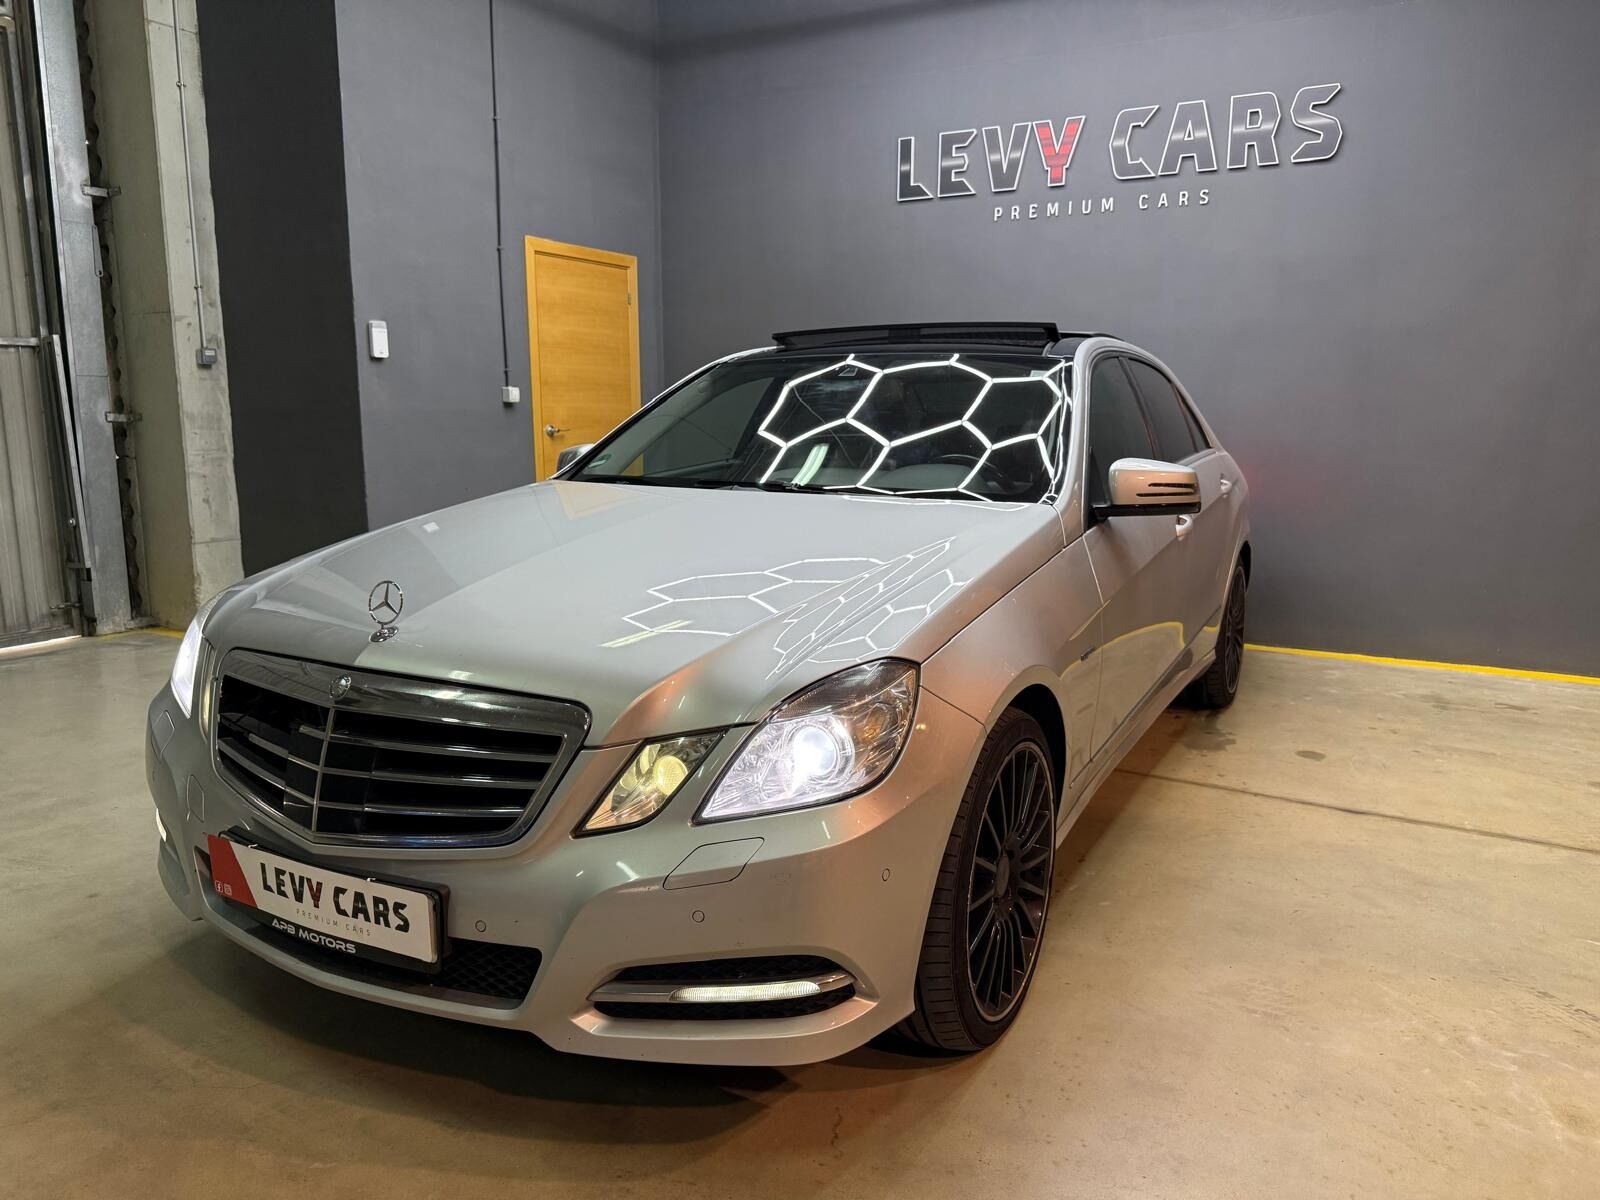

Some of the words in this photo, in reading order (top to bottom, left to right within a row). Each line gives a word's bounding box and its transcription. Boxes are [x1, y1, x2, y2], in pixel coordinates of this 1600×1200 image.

[896, 115, 1086, 202] LEVY
[1108, 83, 1343, 181] CARS
[993, 196, 1115, 221] PREMIUM
[1138, 189, 1210, 209] CARS
[259, 862, 323, 909] LEVY
[332, 886, 410, 933] CARS
[271, 918, 296, 935] APB
[298, 928, 356, 954] MOTORS
[295, 908, 339, 926] PREMIUM
[345, 923, 372, 936] CARS
